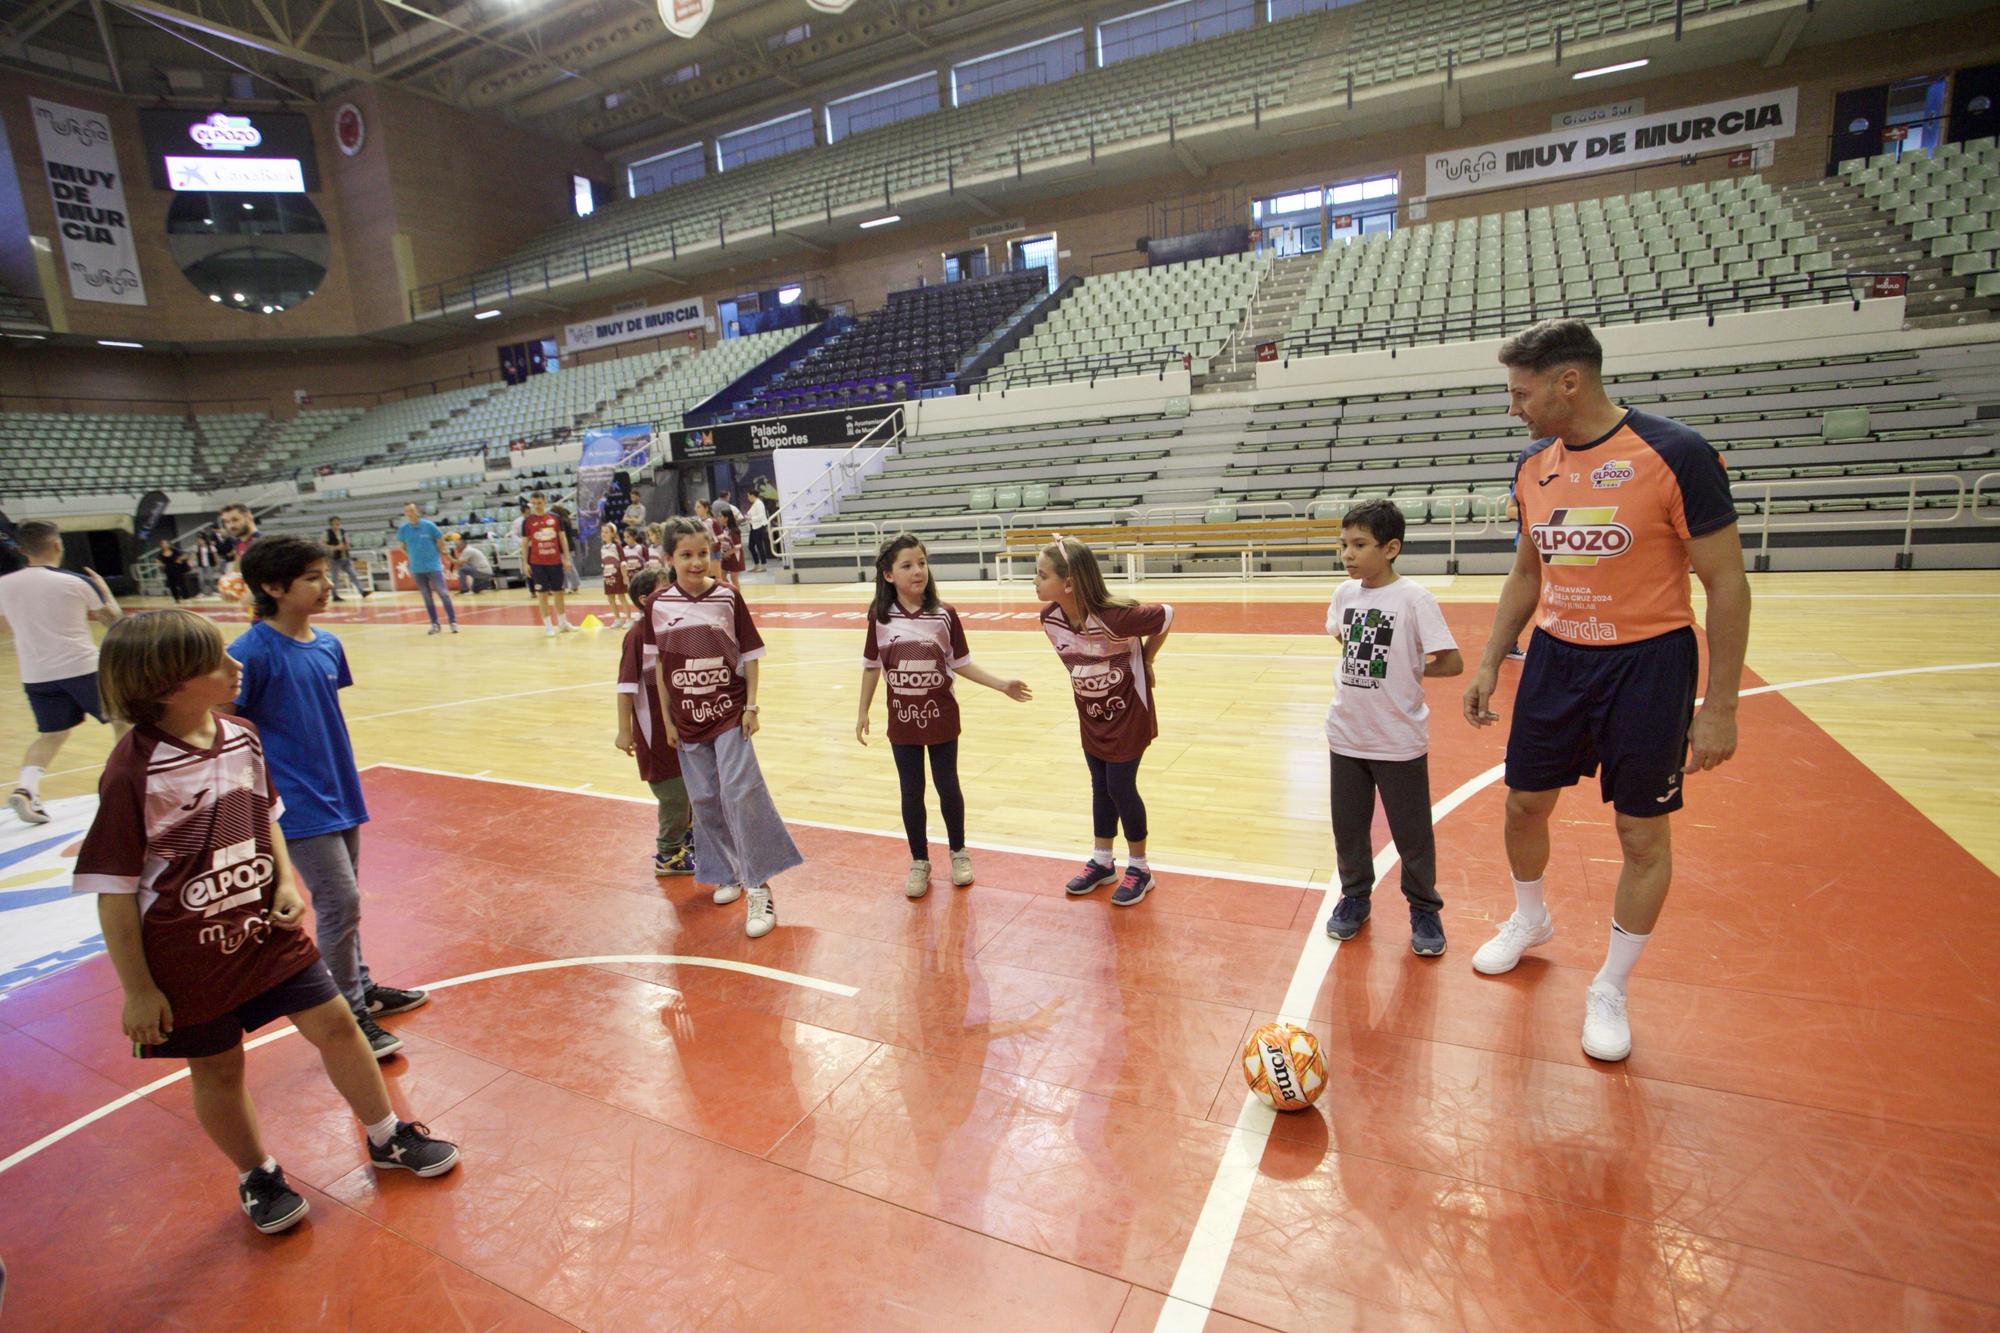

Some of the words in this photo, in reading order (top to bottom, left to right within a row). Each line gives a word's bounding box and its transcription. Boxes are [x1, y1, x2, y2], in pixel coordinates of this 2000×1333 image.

[1506, 140, 1579, 173] MUY
[1586, 132, 1627, 159] DE
[1635, 103, 1784, 150] MURCIA
[47, 161, 115, 190] MUY
[52, 181, 91, 204] DE
[56, 200, 126, 229] MUR
[61, 222, 116, 246] CIA
[596, 321, 624, 339] MUY
[627, 317, 642, 332] DE
[645, 304, 700, 328] MURCIA
[750, 422, 787, 437] Palacio
[761, 433, 809, 450] Deportes
[1569, 473, 1580, 483] 12
[1592, 594, 1613, 602] 2024
